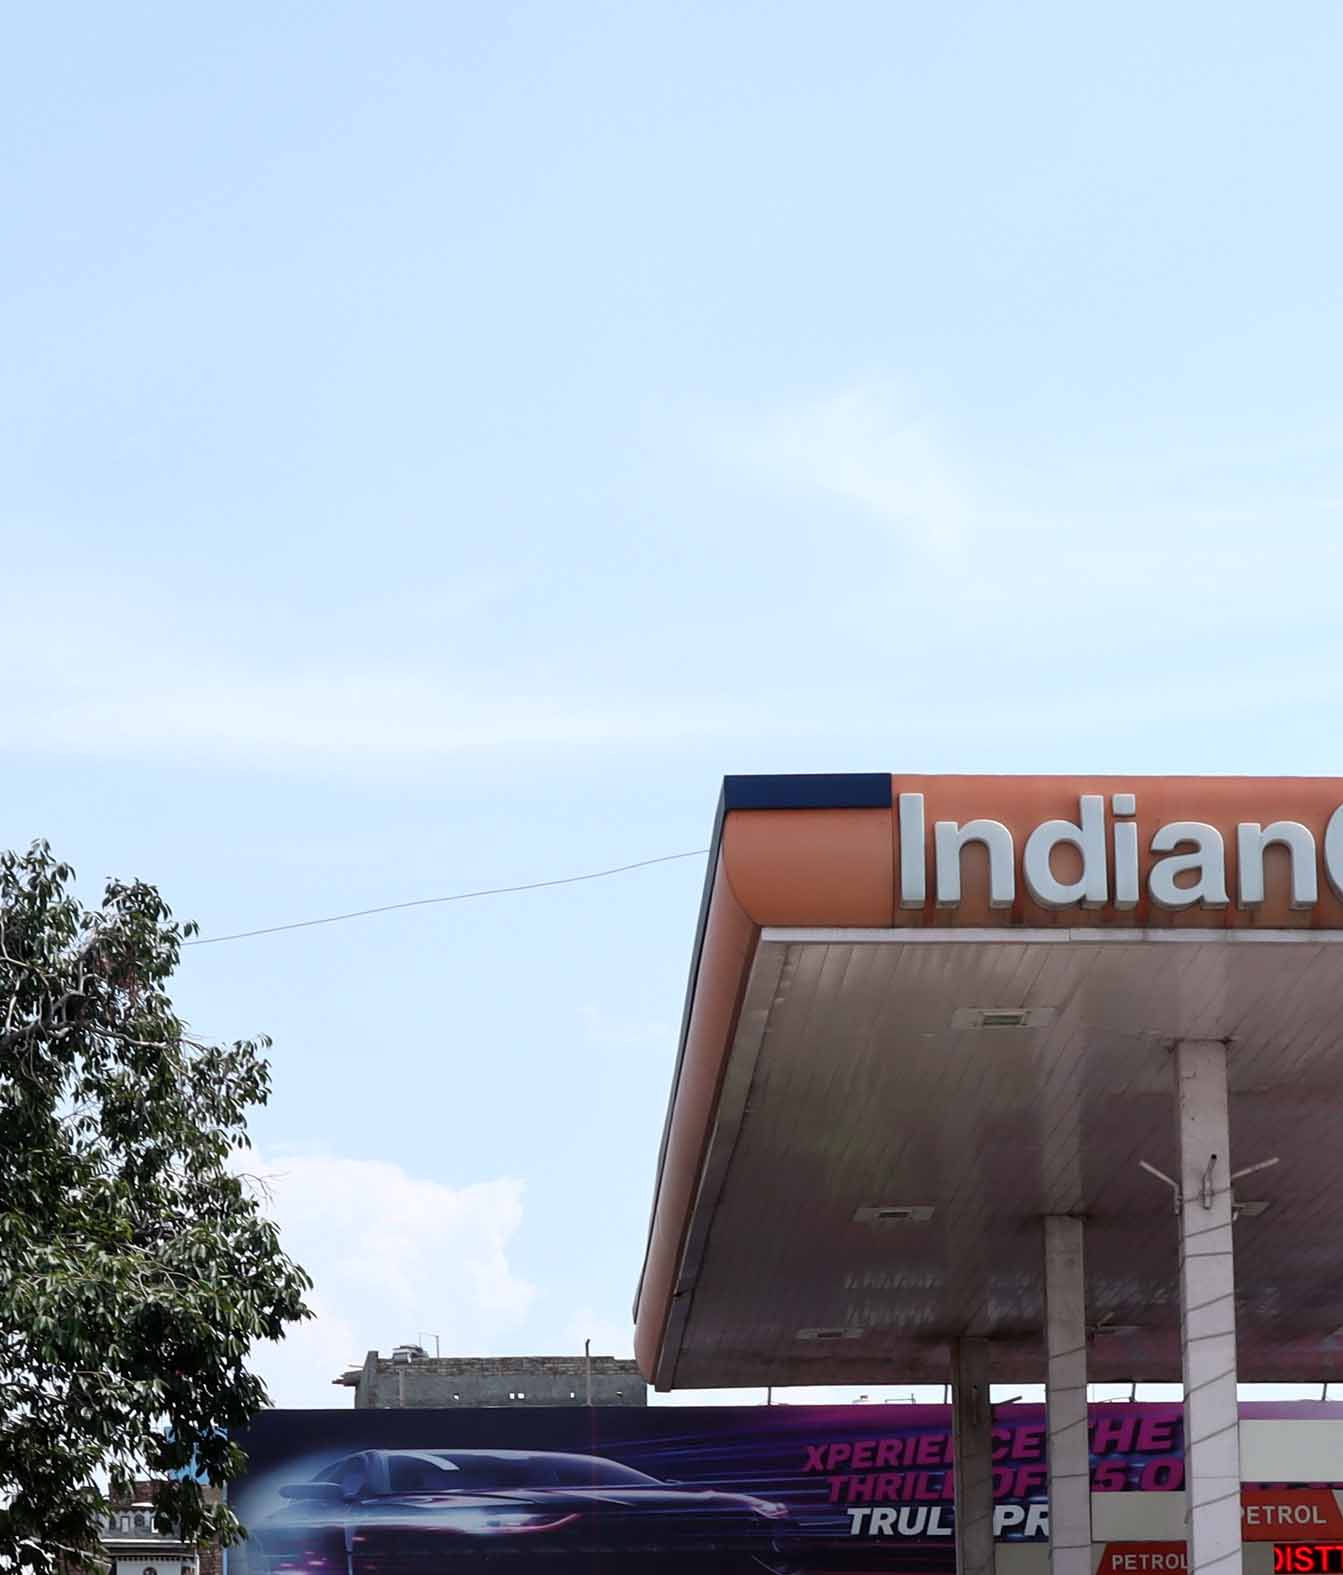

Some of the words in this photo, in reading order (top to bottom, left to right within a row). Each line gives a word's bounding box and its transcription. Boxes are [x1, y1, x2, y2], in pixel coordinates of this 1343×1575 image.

[1088, 1415, 1184, 1454] HE
[848, 1505, 955, 1536] TRUL
[993, 1503, 1049, 1536] PR
[1240, 1505, 1327, 1525] ETROL
[1111, 1554, 1188, 1571] PETROL
